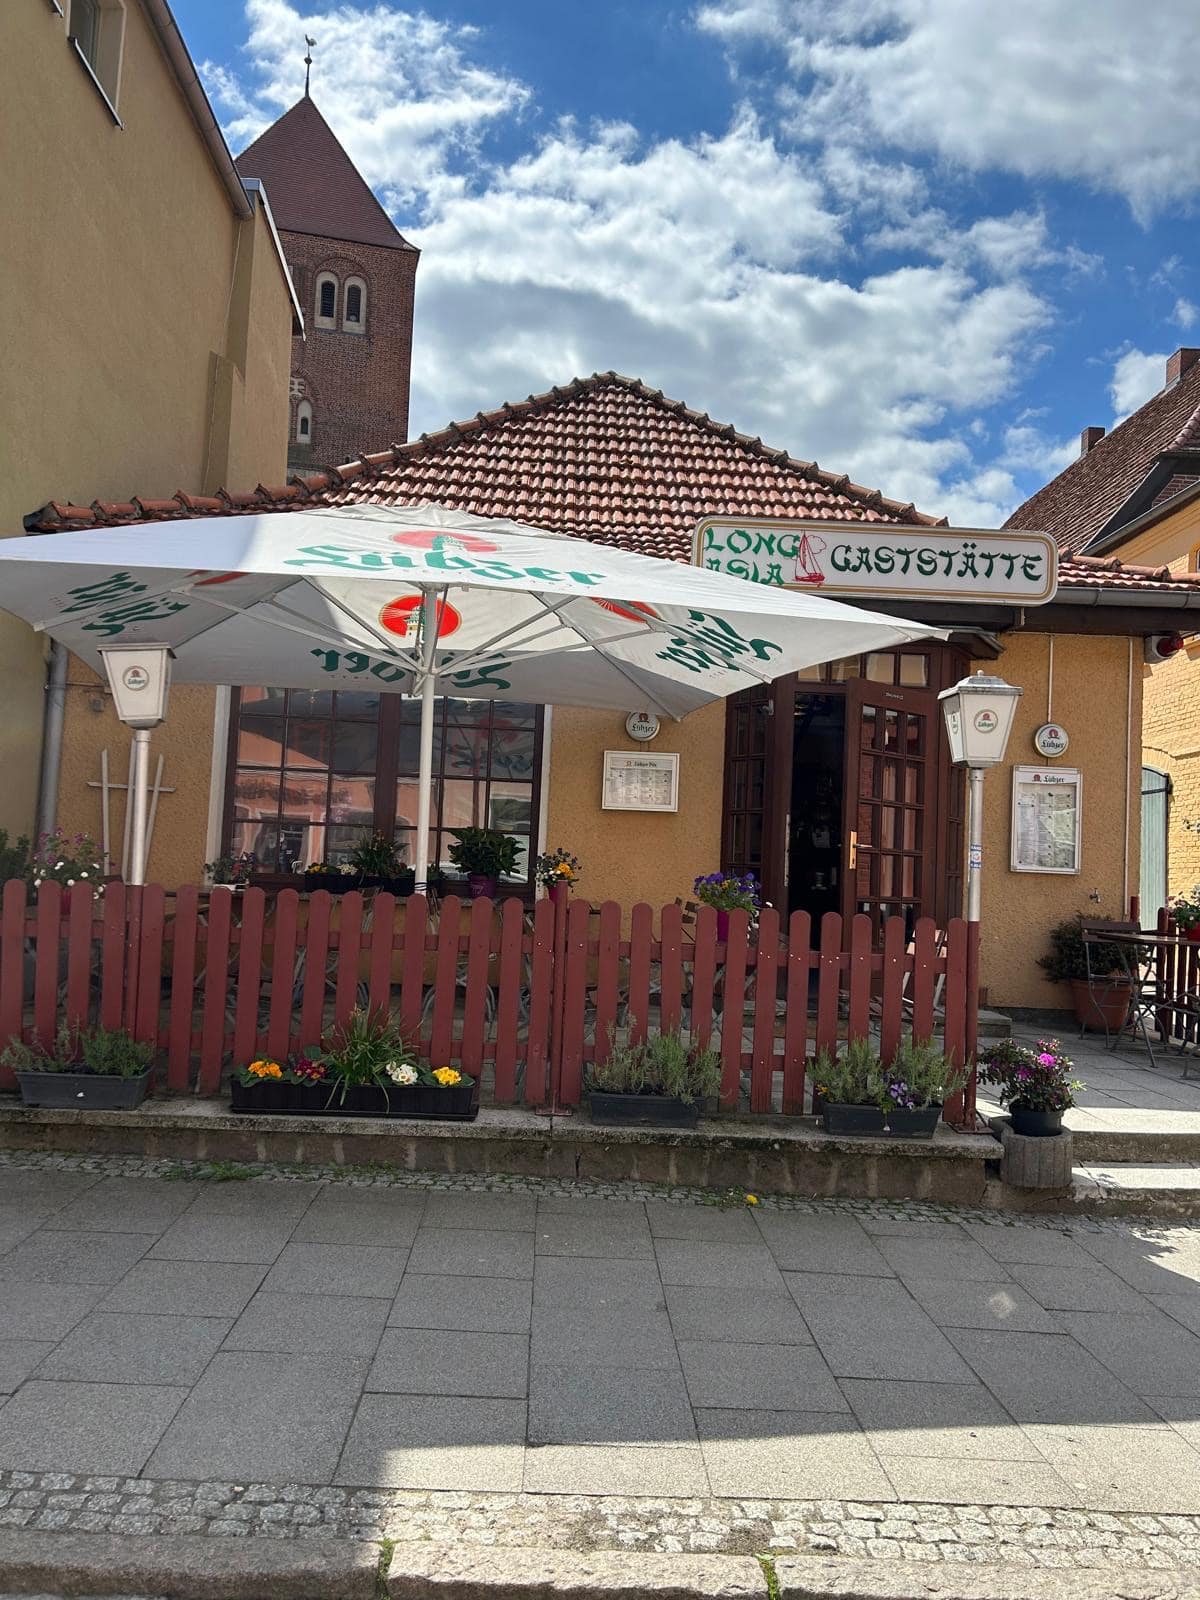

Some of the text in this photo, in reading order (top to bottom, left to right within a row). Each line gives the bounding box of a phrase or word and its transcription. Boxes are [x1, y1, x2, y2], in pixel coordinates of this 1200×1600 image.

[283, 535, 607, 587] Lübzer
[704, 528, 800, 557] LONG
[831, 542, 1042, 581] GASTSTÄTTE
